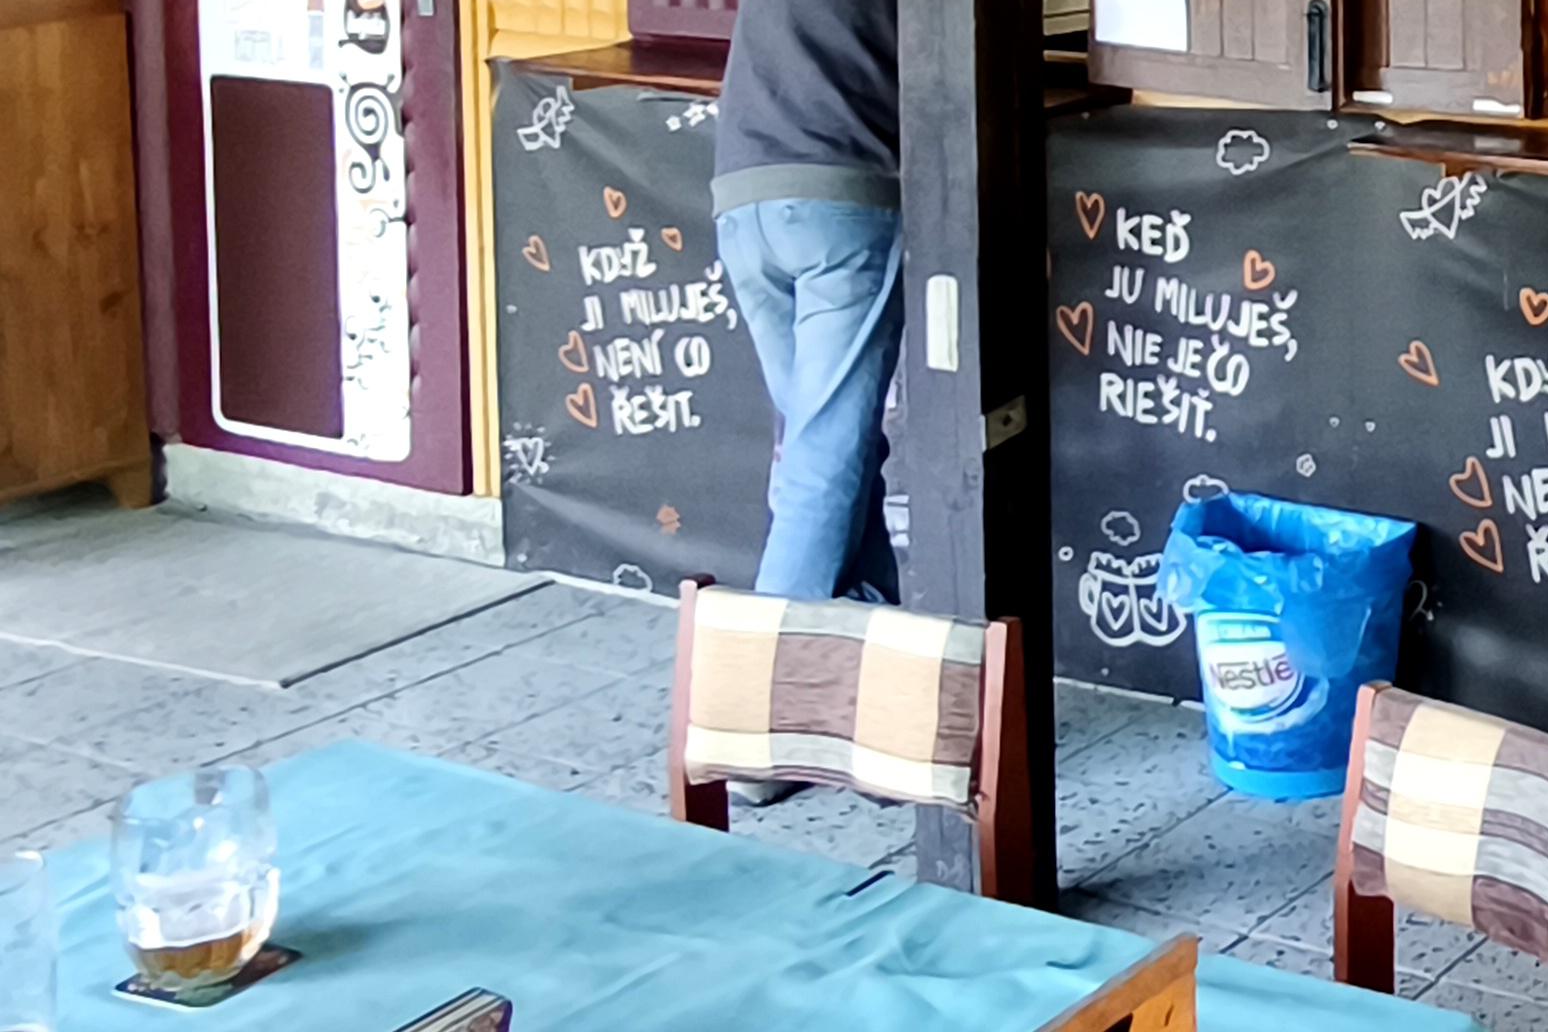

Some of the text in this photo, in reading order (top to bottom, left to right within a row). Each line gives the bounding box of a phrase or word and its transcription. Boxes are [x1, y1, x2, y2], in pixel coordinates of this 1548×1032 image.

[578, 228, 657, 286] KDYŽ
[1105, 265, 1144, 305] JU
[580, 295, 604, 331] JI
[593, 328, 711, 383] NENÍ CO
[1106, 320, 1250, 397] NIE JE ČO
[1486, 414, 1516, 459] JI
[1209, 653, 1296, 691] Nestlé
